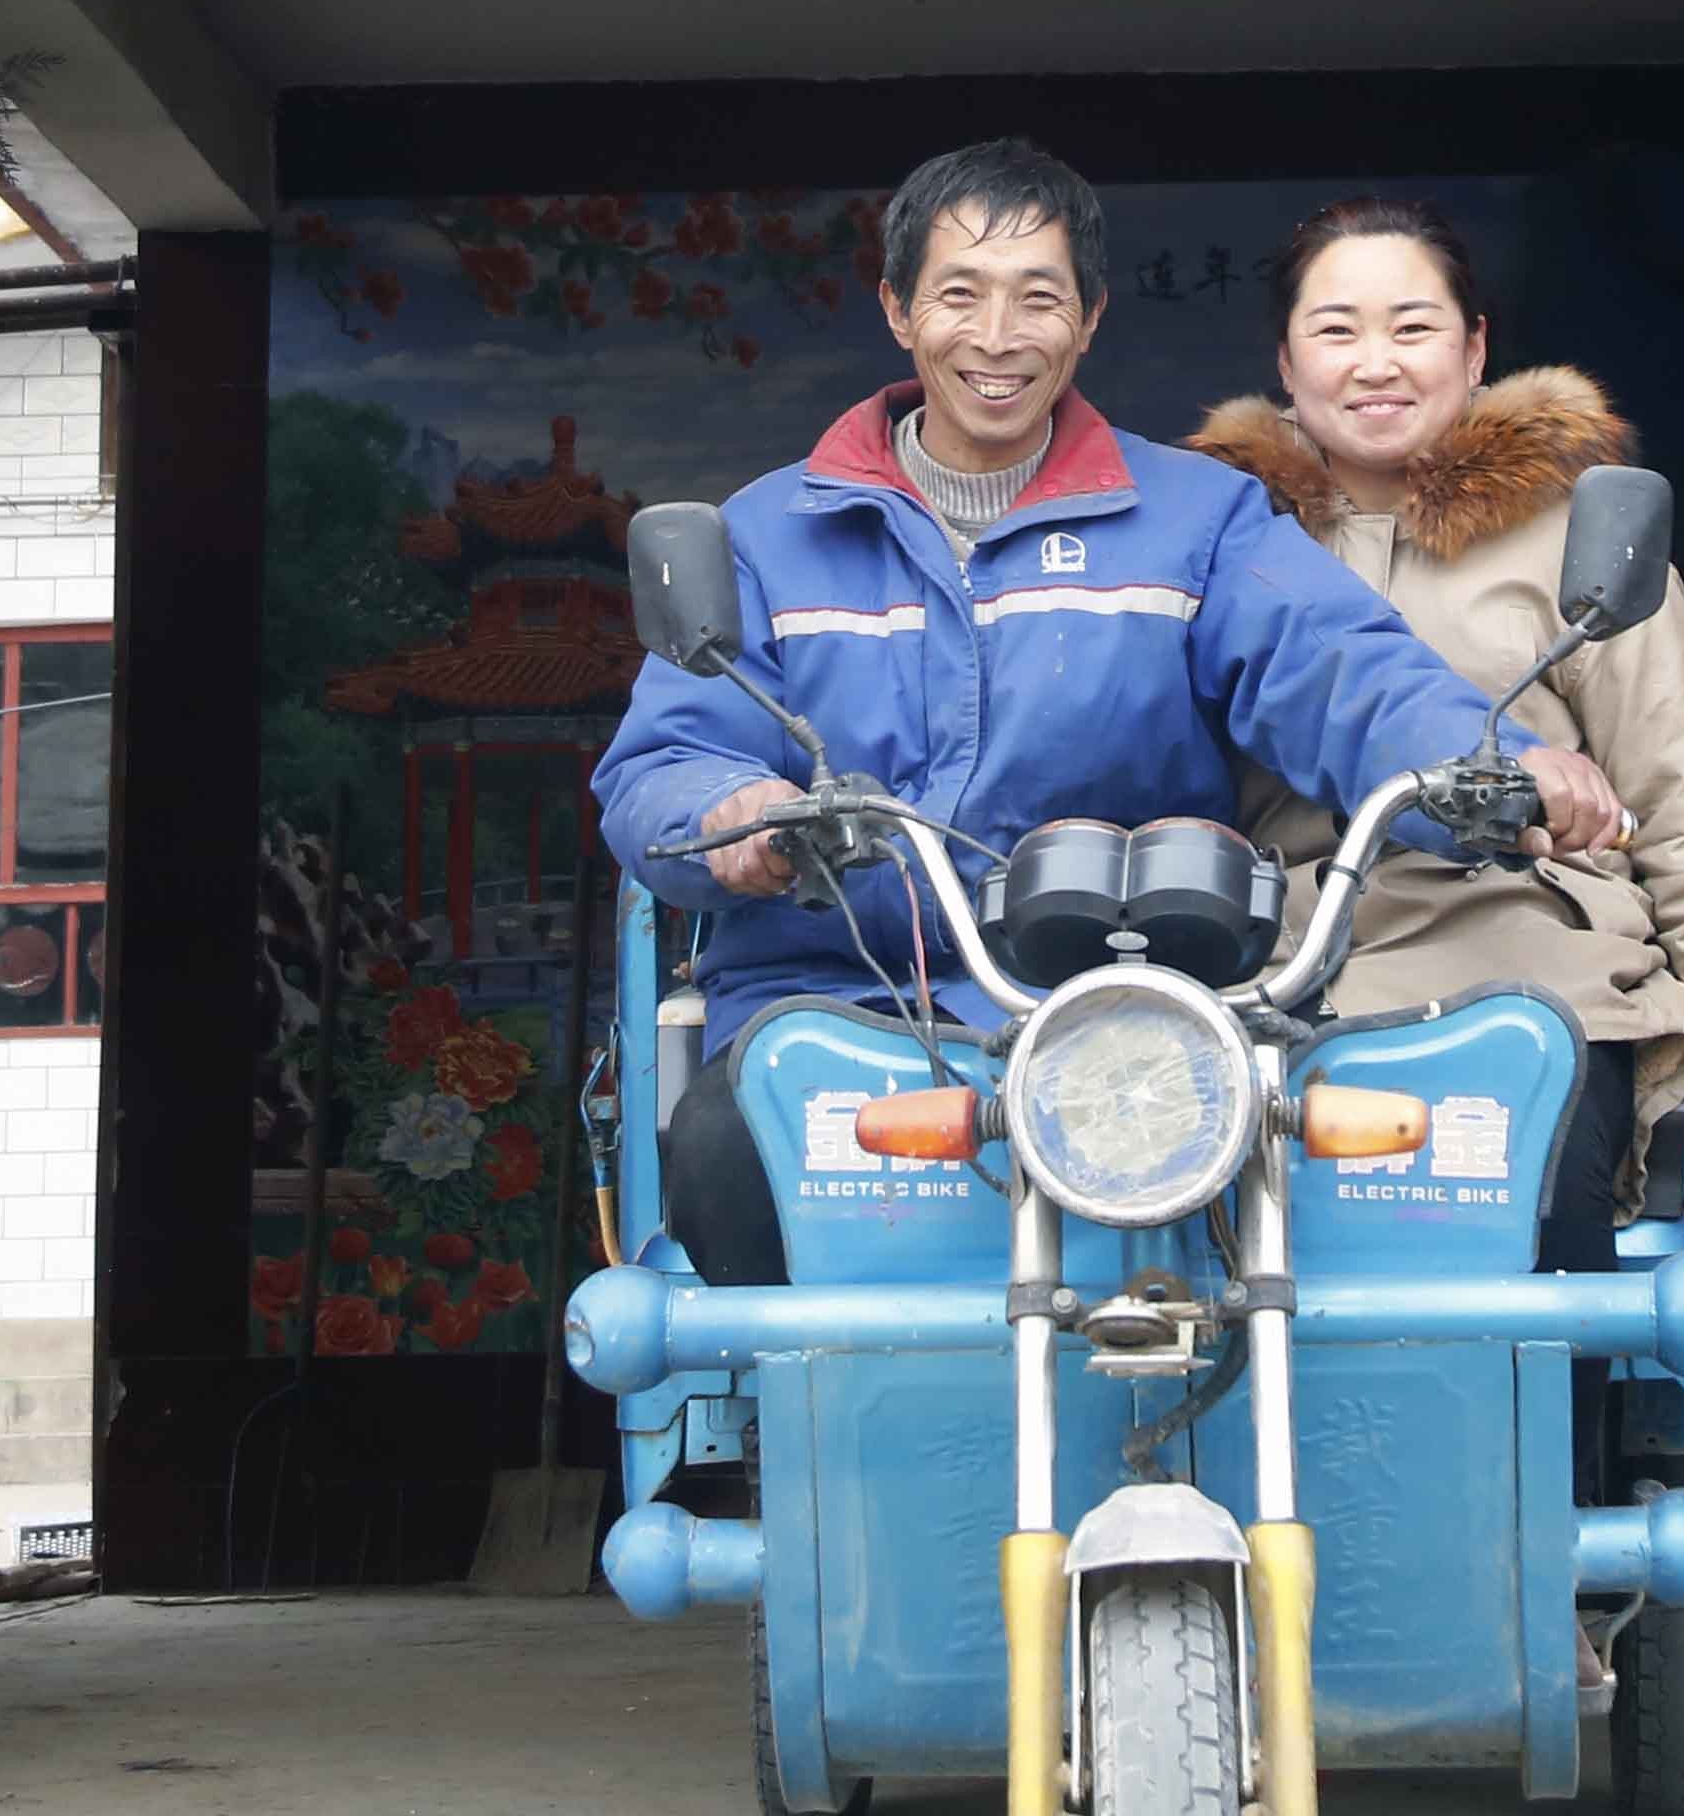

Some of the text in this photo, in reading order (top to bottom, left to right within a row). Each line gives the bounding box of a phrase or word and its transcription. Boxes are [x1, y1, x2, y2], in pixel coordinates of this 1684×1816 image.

[917, 1182, 970, 1198] BIKE
[1338, 1183, 1510, 1204] ELECTRIC BIKE
